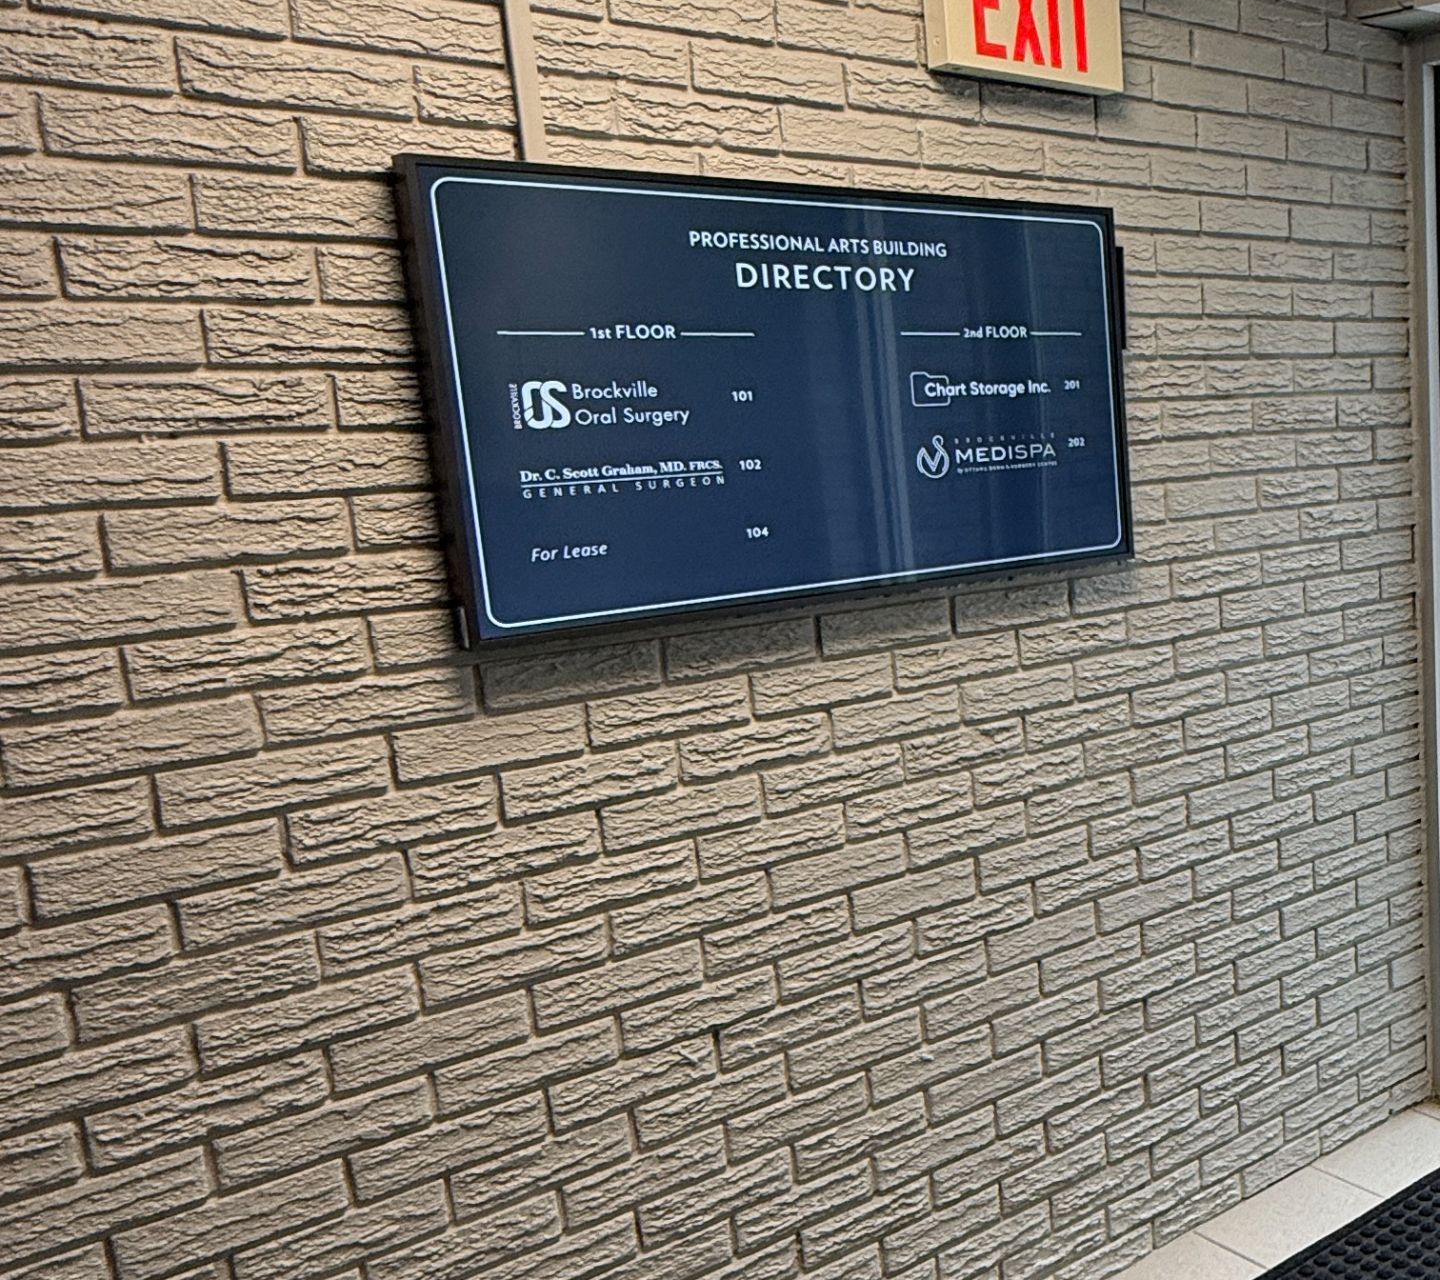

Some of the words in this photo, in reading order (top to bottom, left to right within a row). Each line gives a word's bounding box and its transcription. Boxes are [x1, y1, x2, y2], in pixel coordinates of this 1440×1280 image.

[688, 231, 824, 252] PROFESSIONAL
[828, 238, 869, 255] ARTS
[873, 240, 947, 258] BUILDING
[735, 262, 915, 292] DIRECTORY
[589, 327, 612, 339] 1st
[615, 325, 676, 340] FLOOR
[963, 326, 983, 339] 2nd
[985, 326, 1027, 339] FLOOR
[572, 381, 658, 401] Brockville
[924, 381, 967, 398] Chart
[969, 380, 1026, 398] Storage
[1028, 379, 1051, 394] Inc.
[1064, 380, 1080, 390] 201
[731, 390, 753, 402] 101
[575, 408, 617, 426] Oral
[623, 407, 690, 427] Surgery
[1068, 437, 1085, 448] 202
[955, 443, 1057, 465] MEDISPA
[520, 470, 542, 483] Dr.
[544, 468, 561, 481] C.
[562, 467, 599, 480] Scott
[601, 463, 658, 477] Graham,
[659, 460, 687, 472] MD.
[689, 459, 723, 471] FRCS.
[738, 459, 762, 471] 102
[522, 483, 620, 499] GENERAL
[635, 475, 725, 491] SURGEON
[745, 526, 769, 539] 104
[531, 548, 558, 563] For
[563, 544, 608, 560] Lease
